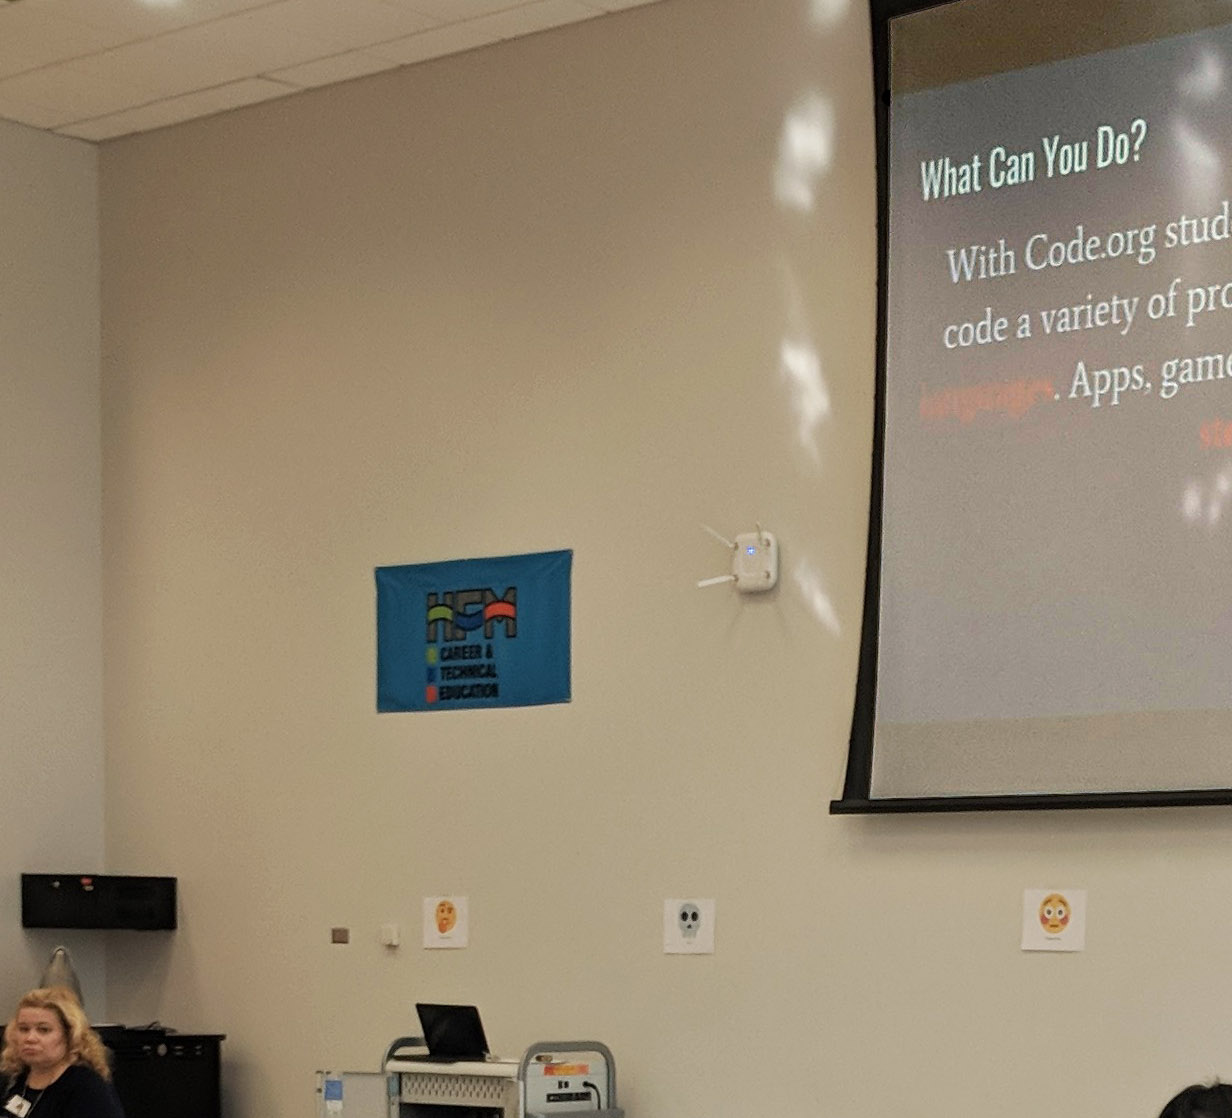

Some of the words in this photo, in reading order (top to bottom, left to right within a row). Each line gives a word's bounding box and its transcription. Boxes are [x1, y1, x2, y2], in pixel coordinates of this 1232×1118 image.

[921, 154, 982, 201] What
[989, 147, 1035, 188] Can
[1042, 135, 1088, 178] You
[1096, 118, 1148, 169] Do?
[947, 239, 1016, 284] With
[1025, 225, 1157, 271] Code.org
[944, 307, 1008, 349] code
[1016, 313, 1031, 339] a
[1040, 293, 1139, 335] variety
[1147, 278, 1182, 319] of
[1068, 361, 1152, 408] Apps,
[440, 663, 498, 680] TECHNICAL
[441, 644, 482, 661] CAREER
[440, 682, 499, 701] EDUCATION
